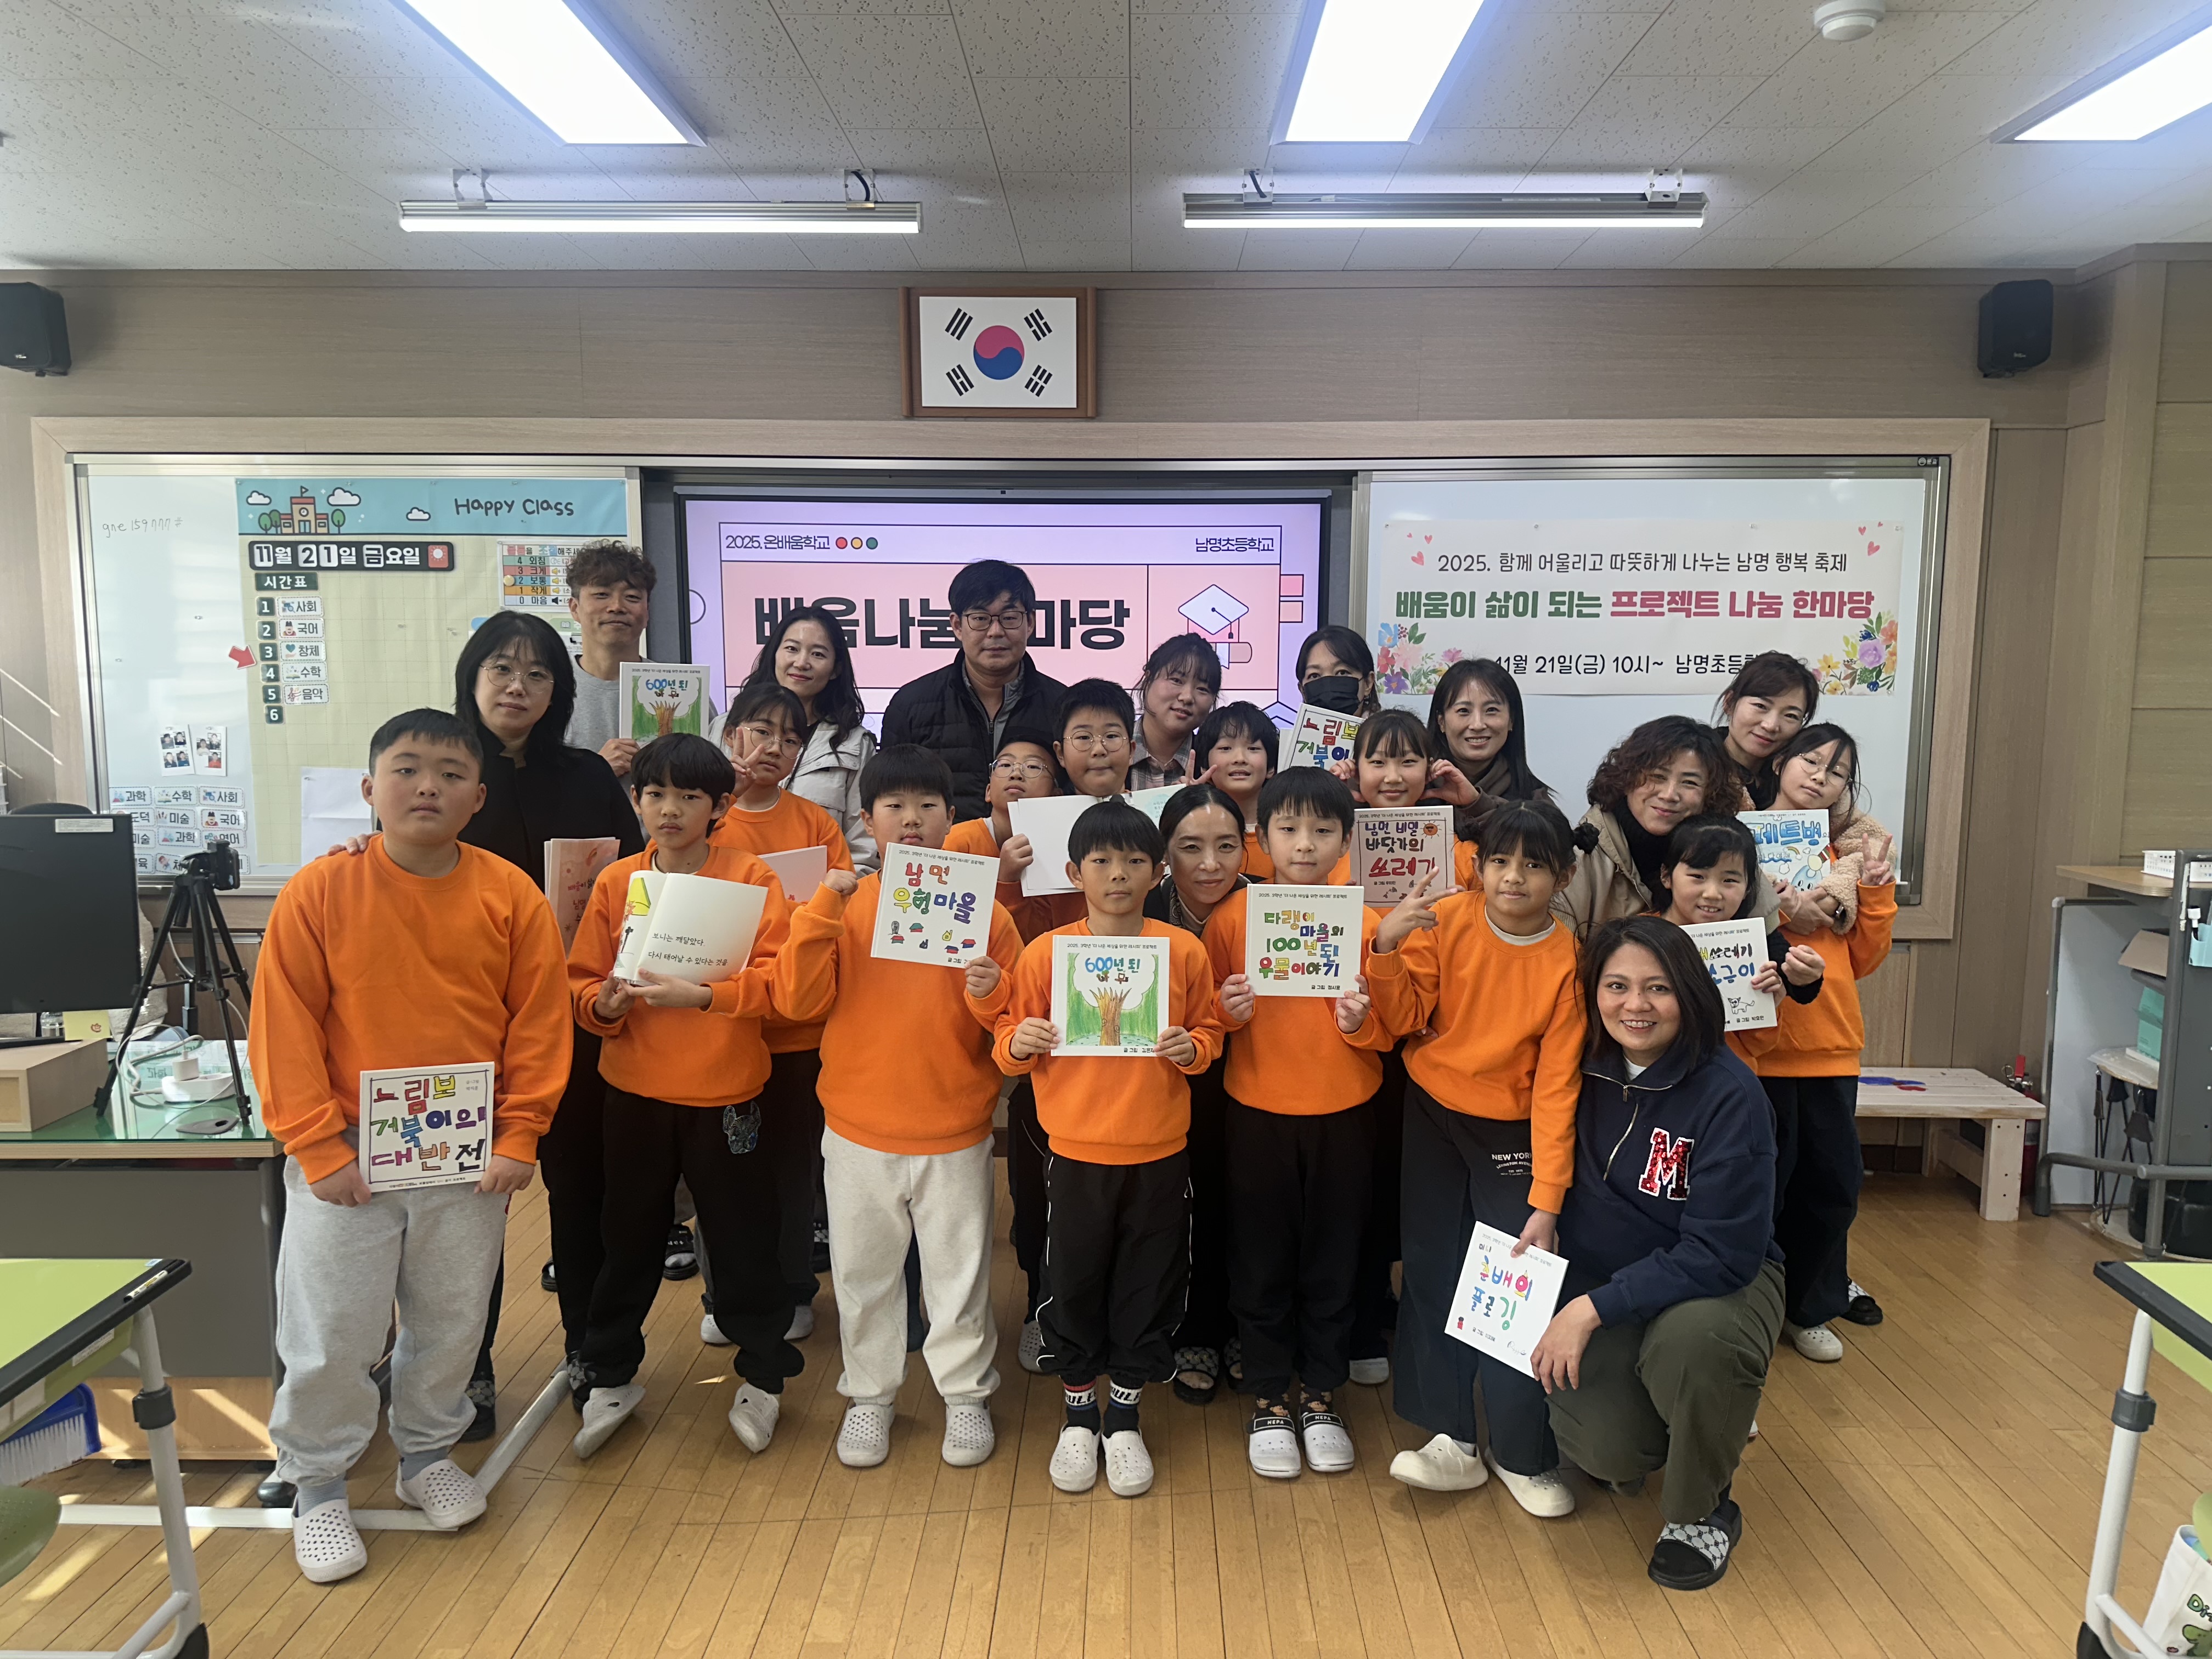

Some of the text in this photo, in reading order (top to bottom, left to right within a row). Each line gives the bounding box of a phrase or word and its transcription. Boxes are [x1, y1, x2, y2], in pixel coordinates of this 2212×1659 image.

[455, 498, 574, 516] Happy Class
[725, 535, 831, 550] 2025. 온배움학교
[1196, 538, 1274, 552] 남명초등학교
[254, 545, 420, 567] 11월 21일 금요일
[529, 556, 545, 565] 외침
[1438, 552, 1847, 573] 2025. 함께 어울리고 따뜻하게 나누는 남명 행복 축제
[518, 566, 546, 575] 3 크게
[263, 575, 307, 589] 시간표
[531, 577, 546, 585] 보통
[531, 586, 547, 595] 작게
[261, 601, 317, 613] 1 사회
[531, 596, 548, 605] 마음
[1396, 591, 1875, 619] 배움이 삶이 되는 프로젝트 나눔 한마당
[262, 623, 318, 636] 2 국어
[264, 645, 319, 658] 3 창체
[1496, 654, 1528, 674] 11월
[1535, 654, 1606, 675] 21일(금)
[1612, 655, 1663, 674] 10시~
[266, 666, 321, 679] 4 수학
[268, 688, 323, 701] 5 음악
[269, 708, 278, 721] 6
[1303, 718, 1359, 746] 느림보
[126, 791, 146, 802] 과학
[172, 790, 193, 802] 수학
[217, 792, 238, 803] 사회
[132, 811, 150, 823] 도덕
[169, 814, 190, 825] 미술
[219, 814, 240, 826] 국어
[175, 832, 196, 844] 과학
[1365, 837, 1424, 854] 바닷가의
[1265, 910, 1314, 930] 다랭이
[1300, 923, 1344, 942] 마을의
[1267, 937, 1317, 956] 100년
[1320, 944, 1339, 963] 된
[648, 951, 662, 960] 다시
[1085, 956, 1141, 973] 600년 된
[374, 1075, 456, 1115] 느림보
[370, 1106, 486, 1148] 거북이의
[371, 1138, 486, 1172] 대반전
[1638, 1127, 1695, 1200] M
[1471, 1286, 1517, 1330] 플로깅
